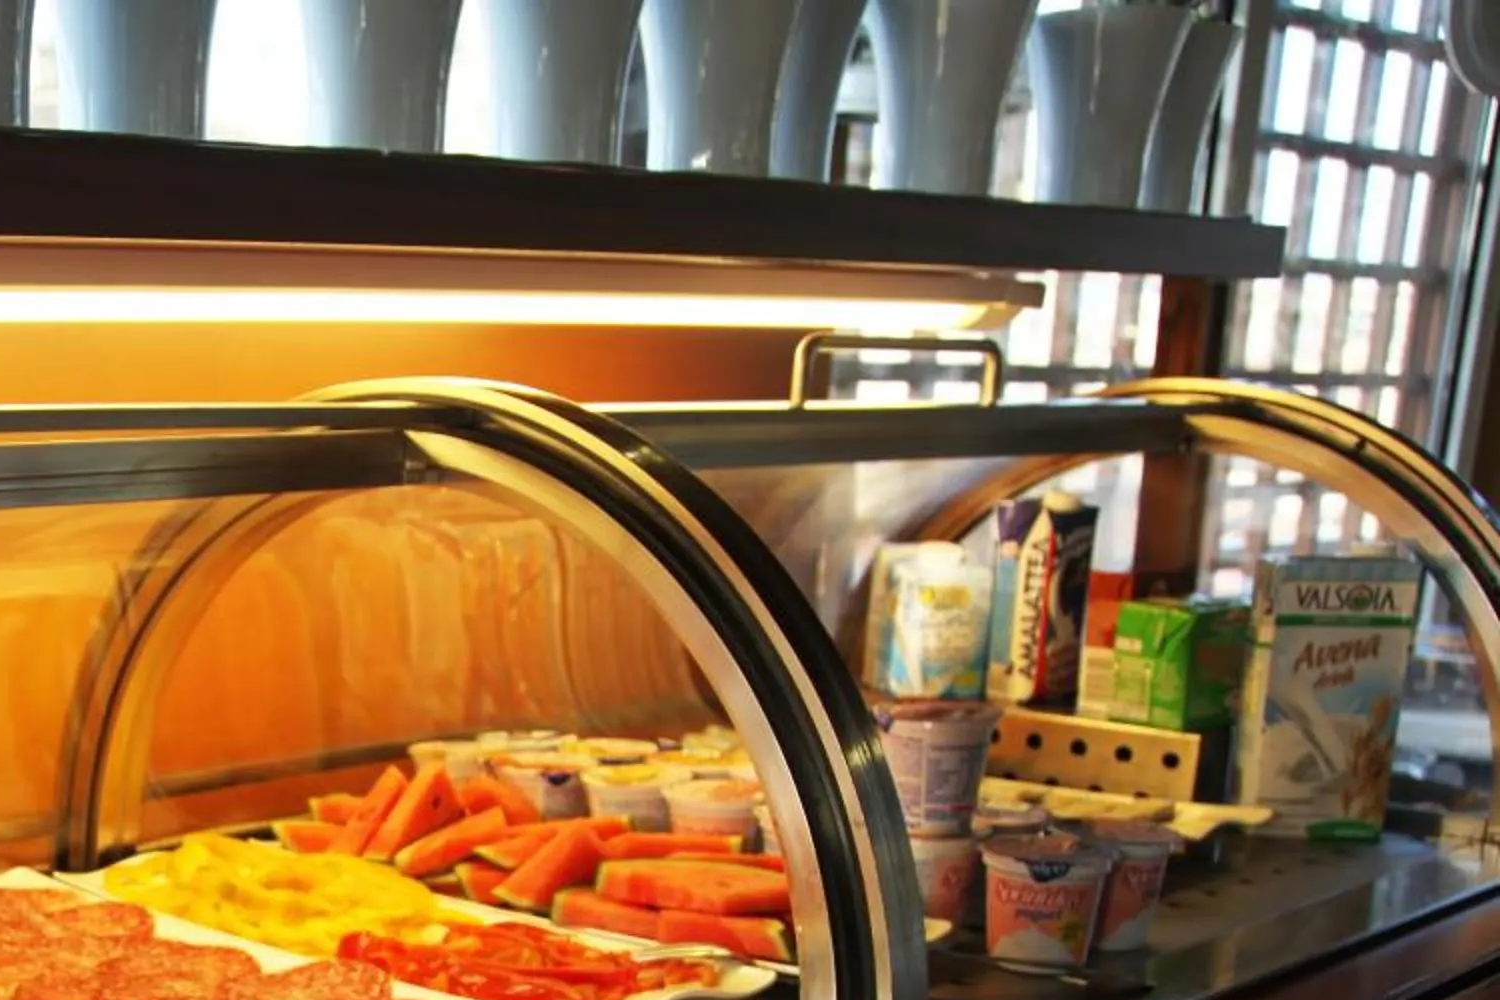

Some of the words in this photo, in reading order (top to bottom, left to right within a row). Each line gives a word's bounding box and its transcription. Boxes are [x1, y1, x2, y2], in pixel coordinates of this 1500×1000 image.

[1017, 538, 1050, 679] AMALATTEA
[1296, 583, 1396, 611] VALSOIA
[1293, 633, 1382, 676] Avena
